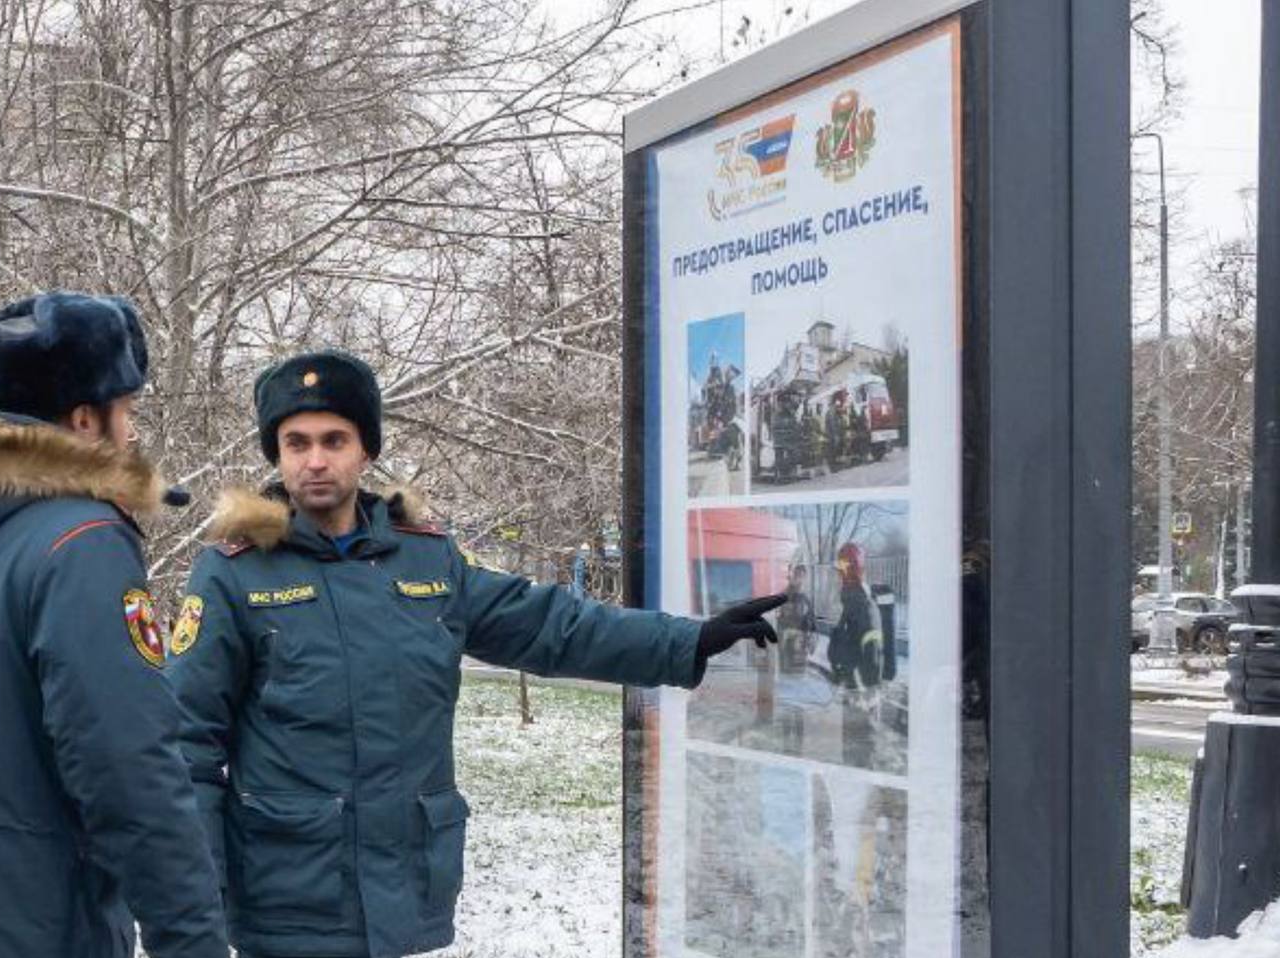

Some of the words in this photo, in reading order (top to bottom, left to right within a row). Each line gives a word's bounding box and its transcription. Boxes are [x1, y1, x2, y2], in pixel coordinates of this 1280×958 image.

[673, 218, 818, 278] ПРЕДОТВРАЩЕНИЕ,
[822, 185, 929, 236] СПАСЕНИЕ,
[751, 256, 829, 295] ПОМОЩЬ
[249, 591, 271, 603] МЧС
